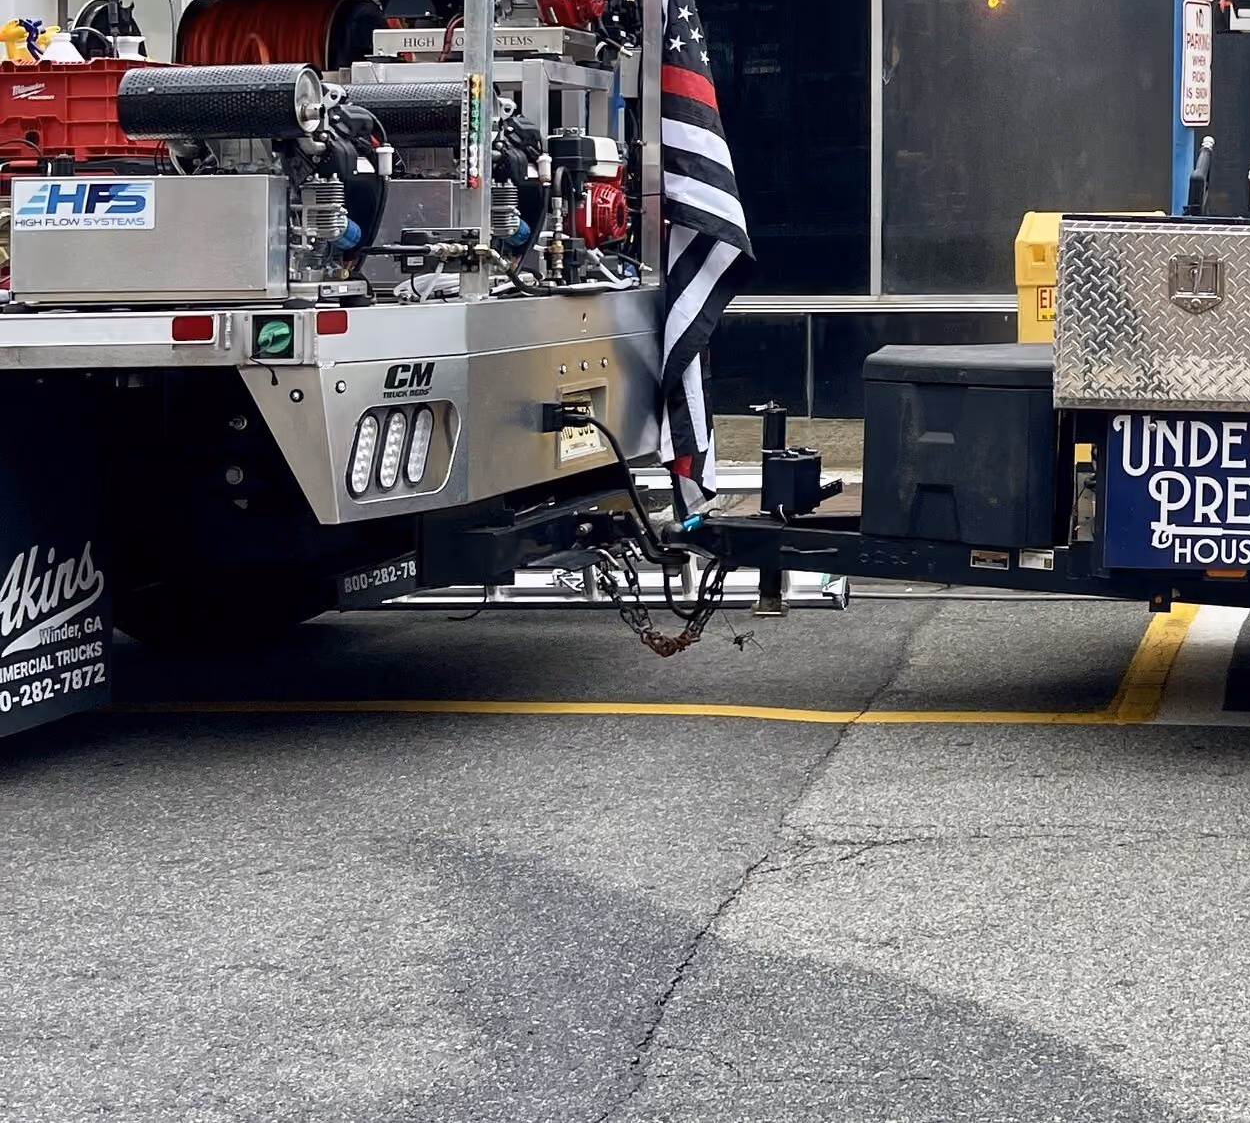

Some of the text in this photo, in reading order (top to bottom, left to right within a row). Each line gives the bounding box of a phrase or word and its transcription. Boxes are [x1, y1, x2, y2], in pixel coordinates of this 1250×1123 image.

[1196, 10, 1204, 29] NO
[403, 36, 533, 48] HIGH STEMS
[1186, 32, 1210, 52] PARKING
[1186, 87, 1193, 100] IS
[46, 183, 152, 214] HFS
[15, 217, 145, 227] HIGH FLOW SYSTEMS
[384, 362, 435, 389] CM
[383, 388, 431, 399] TRUCK BEDS
[344, 560, 417, 593] 800-282-78
[39, 616, 102, 645] Winder, GA
[56, 641, 103, 667] TRUCKS
[0, 663, 106, 713] 0-282-7872
